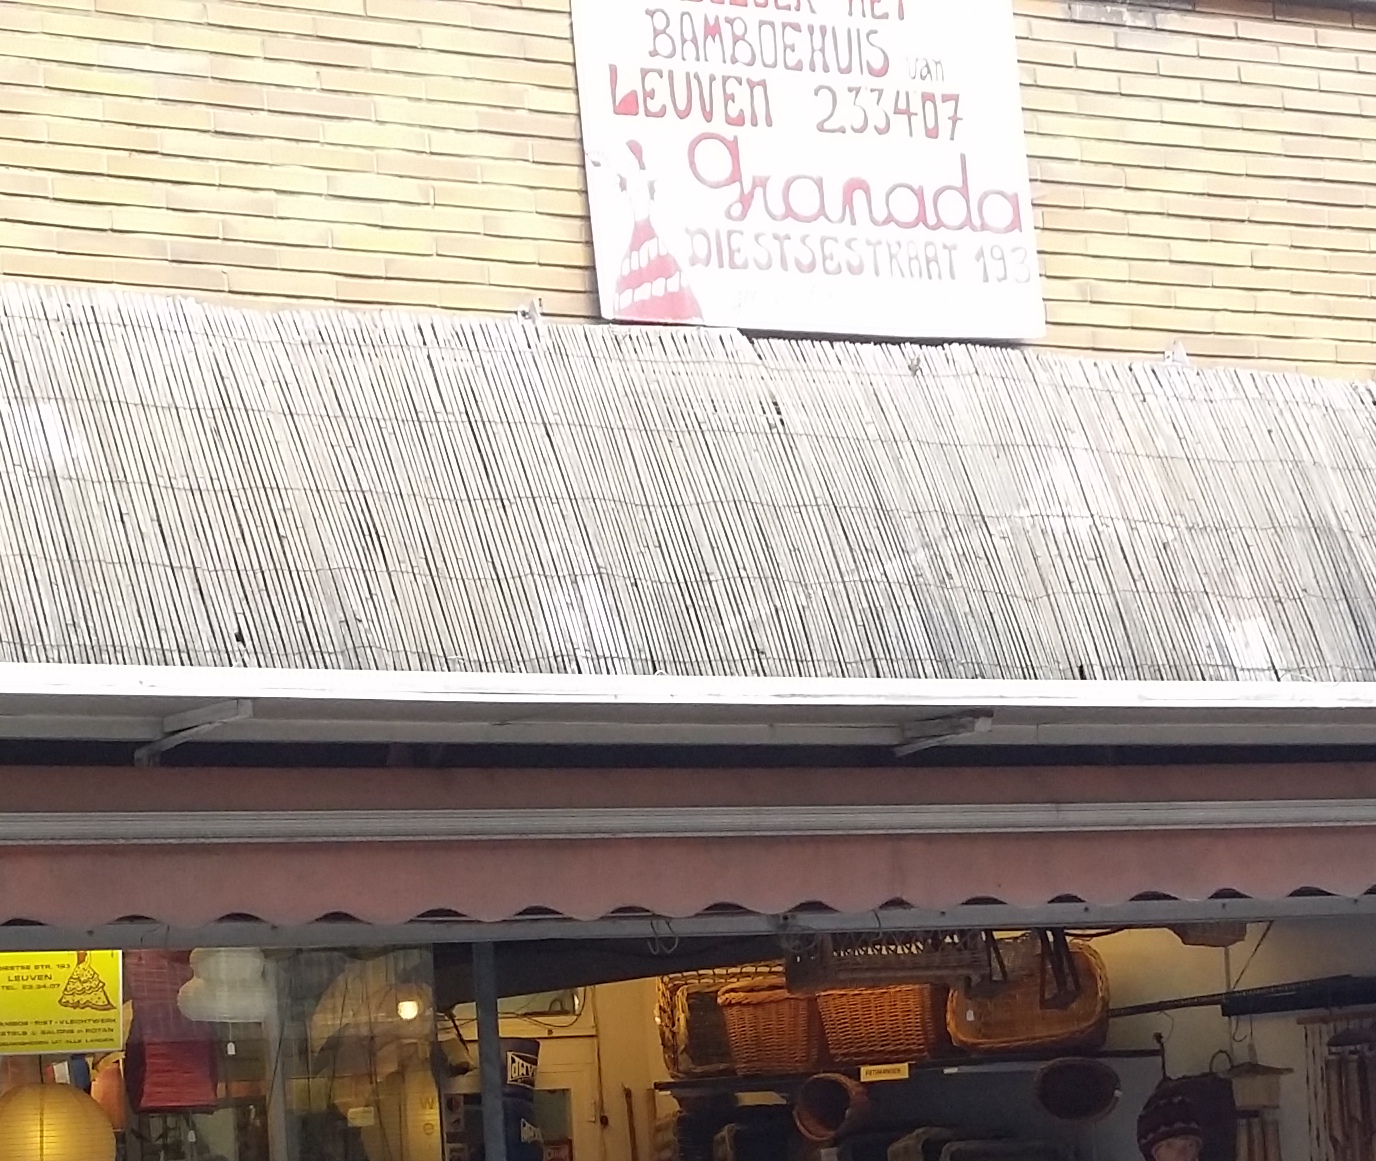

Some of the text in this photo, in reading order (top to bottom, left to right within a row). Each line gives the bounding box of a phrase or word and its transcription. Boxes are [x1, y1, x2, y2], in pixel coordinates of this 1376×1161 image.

[645, 7, 891, 78] BAMBOEHUIS
[607, 63, 964, 141] LEUVEN 233407
[7, 973, 53, 982] LEUVEN
